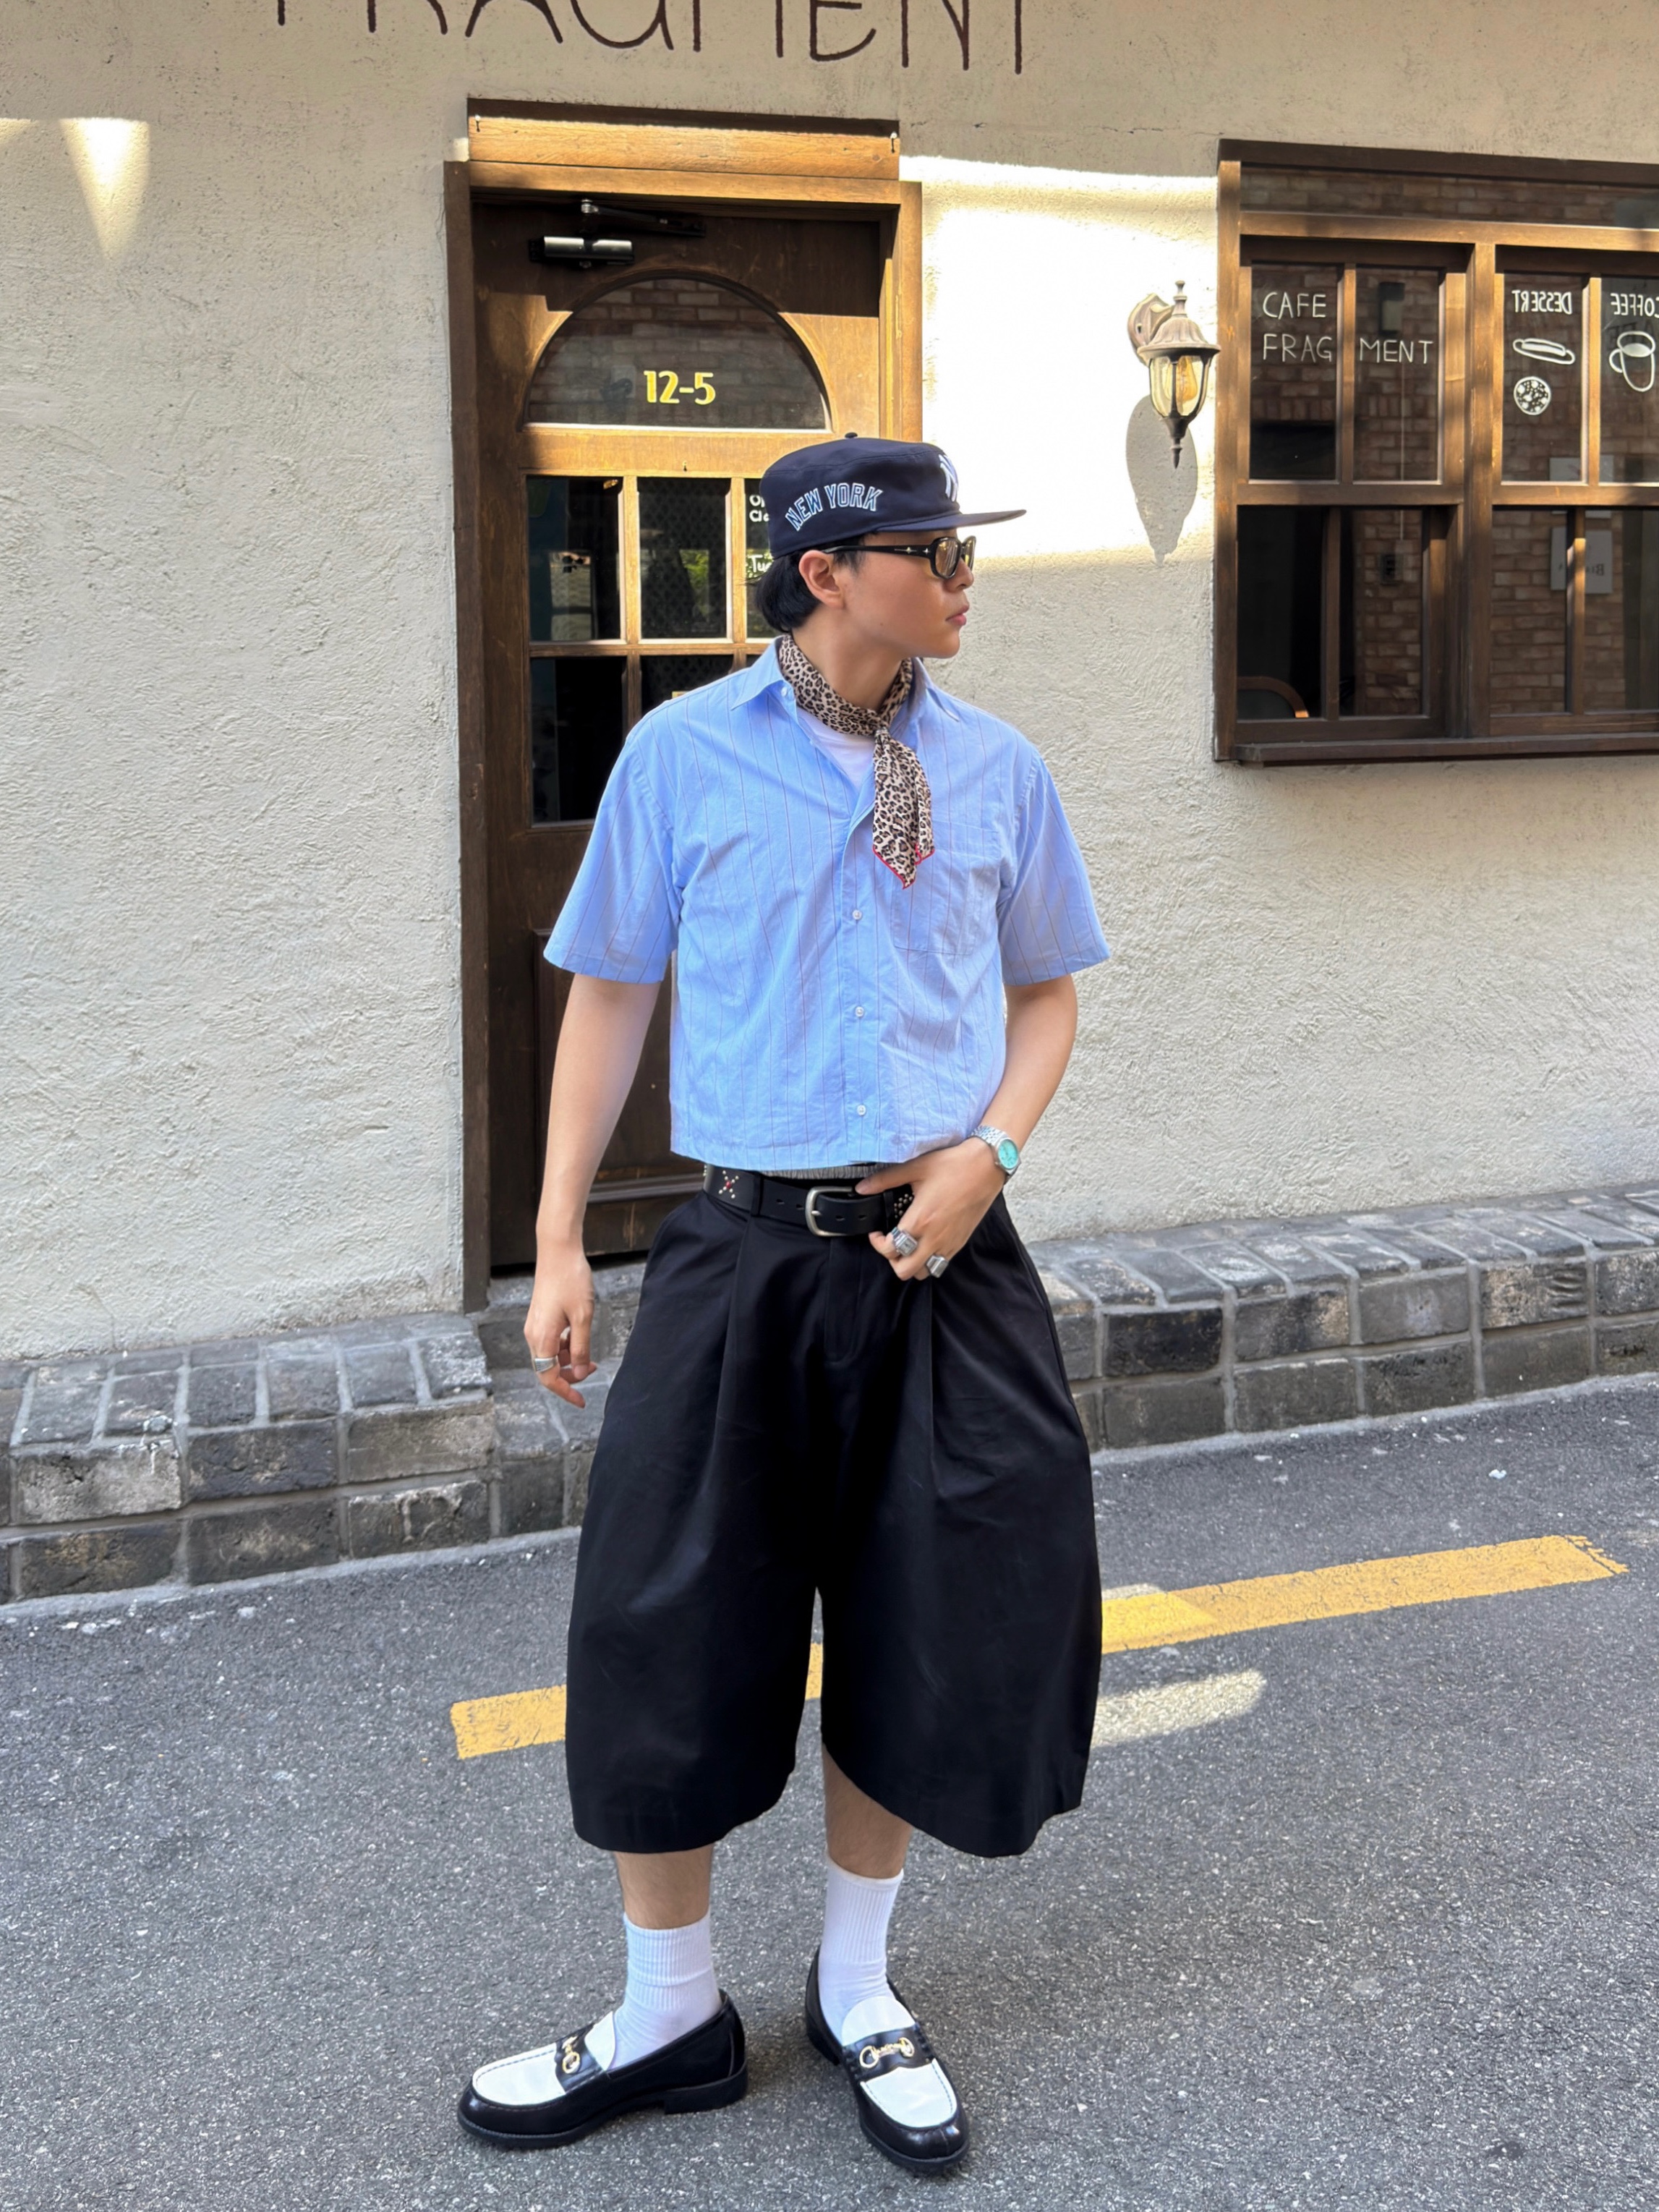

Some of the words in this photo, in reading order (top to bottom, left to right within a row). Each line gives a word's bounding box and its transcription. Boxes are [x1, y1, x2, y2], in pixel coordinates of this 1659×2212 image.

[1263, 292, 1326, 320] CAFE
[644, 370, 716, 405] 12-5
[785, 488, 823, 532] NEW
[824, 482, 883, 512] YORK
